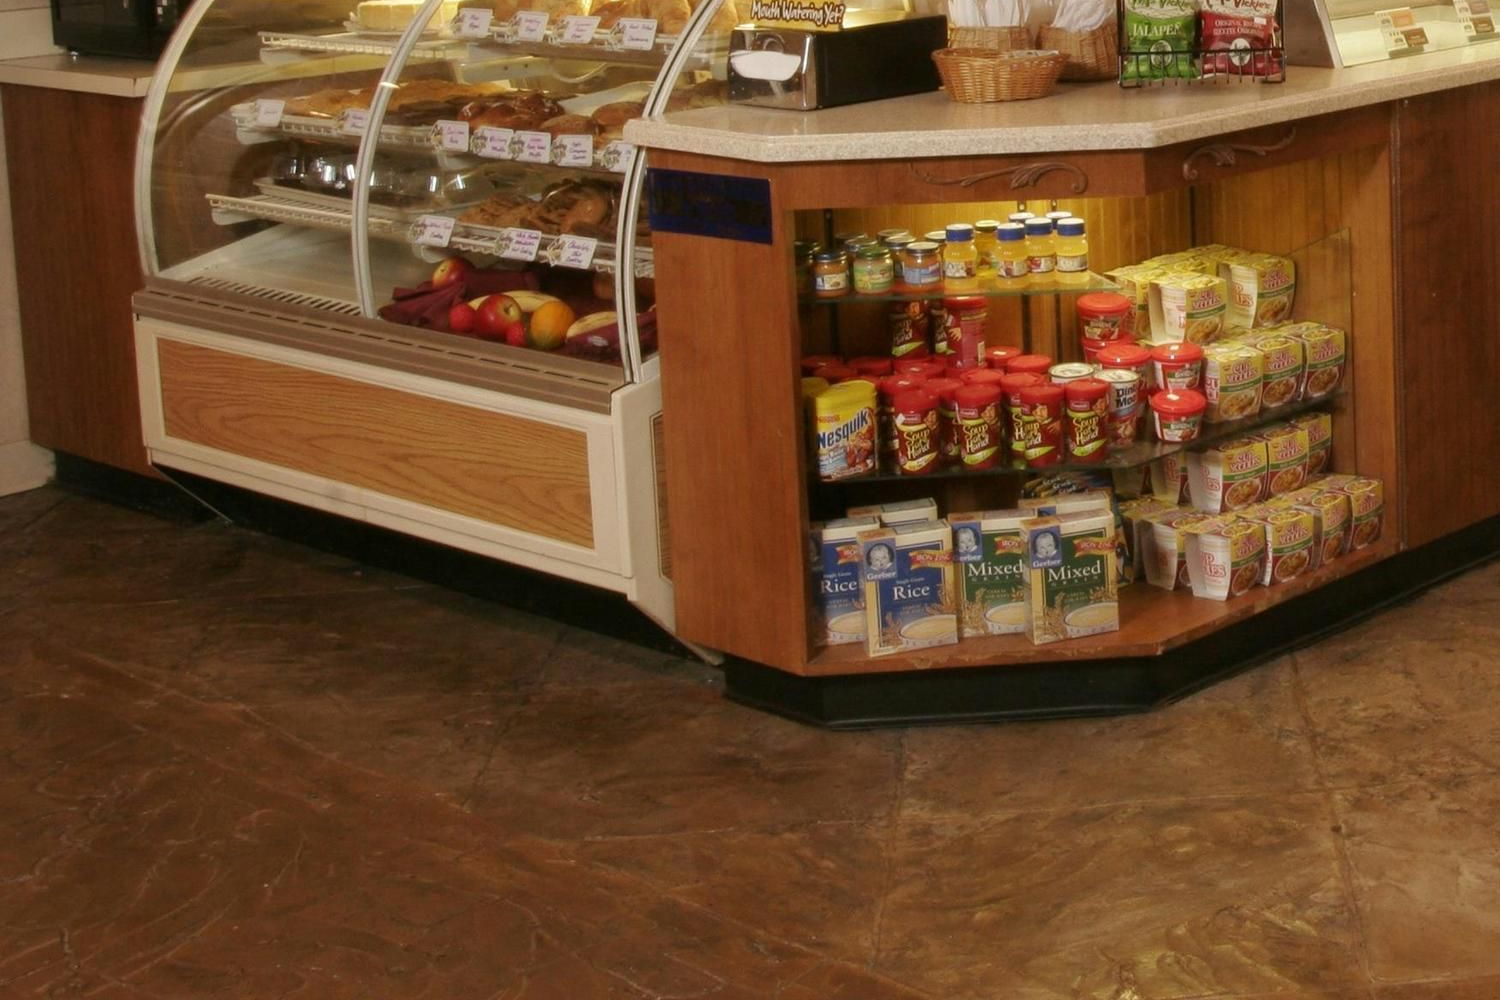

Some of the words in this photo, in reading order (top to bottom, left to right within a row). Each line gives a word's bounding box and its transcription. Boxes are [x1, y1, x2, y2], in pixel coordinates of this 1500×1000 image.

[782, 0, 824, 26] Watering
[824, 3, 846, 24] Yet?
[816, 411, 868, 448] Nesquik
[963, 423, 989, 439] Soup
[1072, 416, 1098, 432] Soup
[903, 429, 930, 445] Soup
[968, 559, 1023, 577] Mixed
[1033, 559, 1061, 567] Gerber
[867, 572, 896, 580] Gerber
[1048, 560, 1101, 583] Mixed
[822, 579, 857, 593] Rice
[893, 585, 930, 601] Rice
